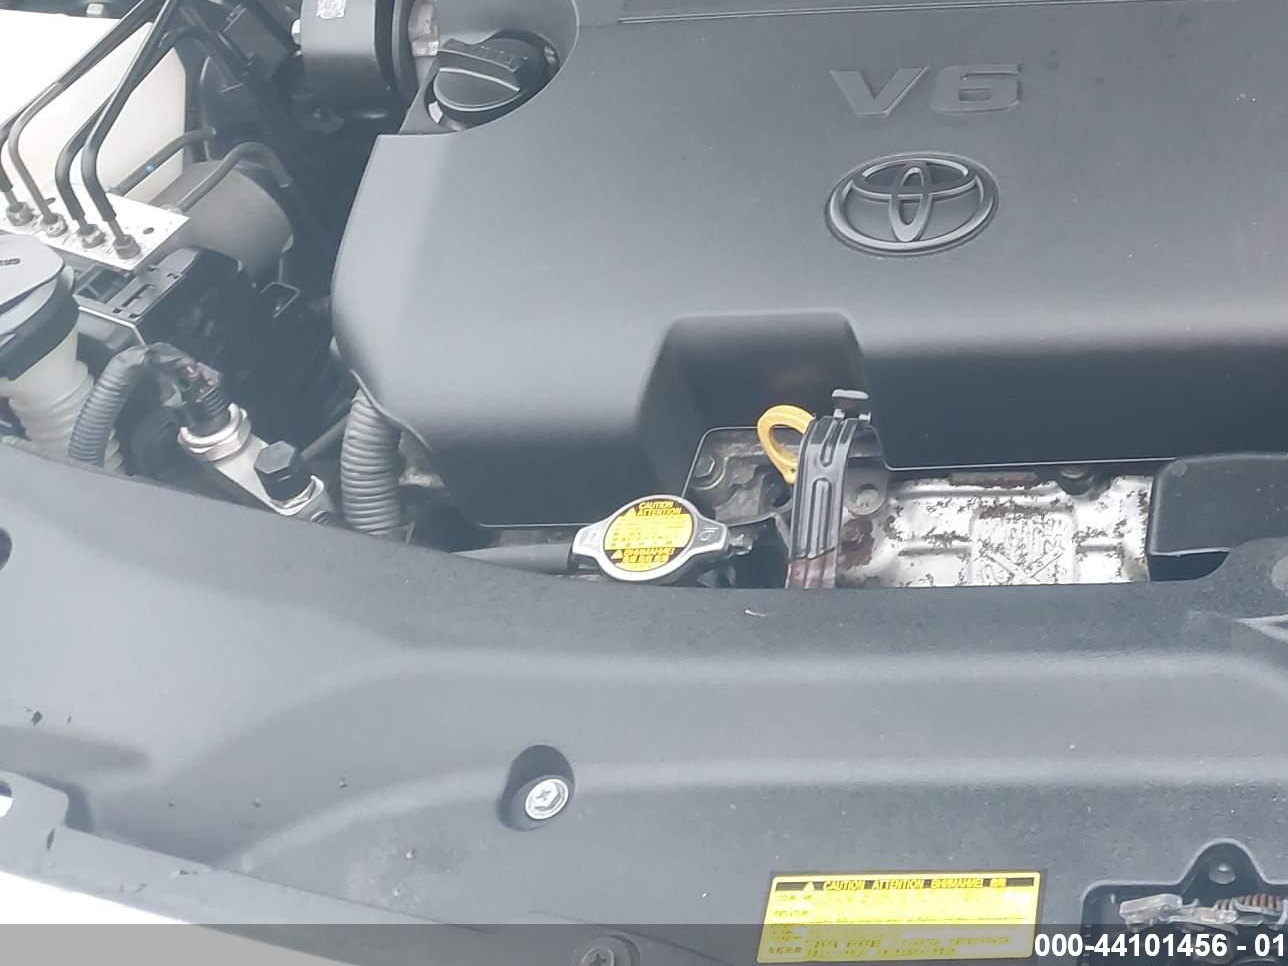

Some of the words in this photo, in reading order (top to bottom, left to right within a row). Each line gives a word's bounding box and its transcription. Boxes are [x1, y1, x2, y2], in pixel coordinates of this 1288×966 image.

[829, 62, 1022, 117] V6
[638, 500, 675, 509] CAUTION
[822, 879, 865, 891] CAUTION
[872, 878, 926, 890] ATTENTION
